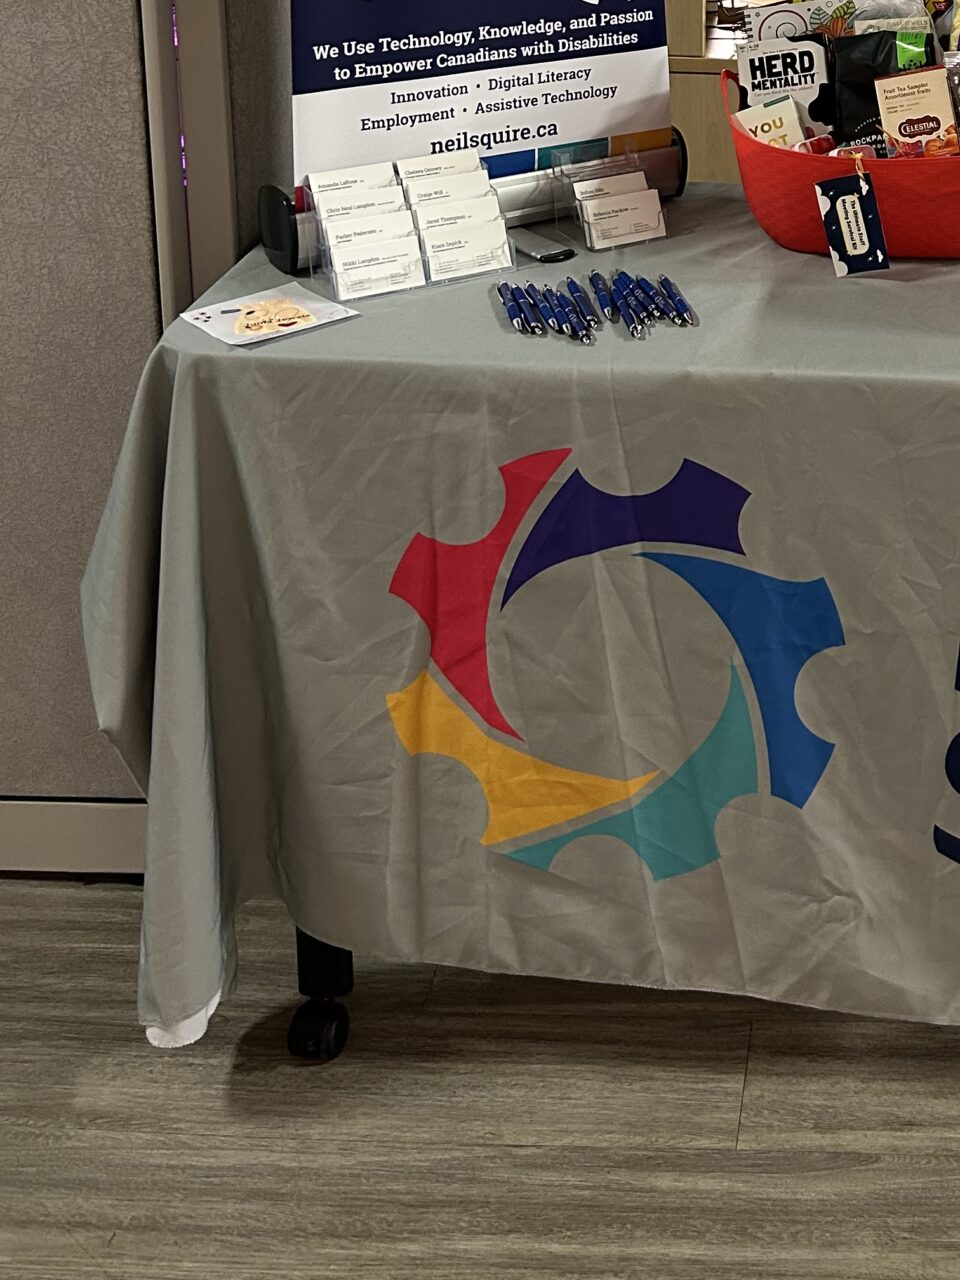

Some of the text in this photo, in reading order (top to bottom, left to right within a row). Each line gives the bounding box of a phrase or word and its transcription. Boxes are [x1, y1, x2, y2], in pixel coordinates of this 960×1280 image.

[313, 8, 654, 60] We Use Technology, Knowledge, and Passion
[334, 32, 639, 81] to Empower Canadians with Disabilities
[748, 50, 815, 80] HERD
[390, 68, 592, 105] Innovation Digital Literacy
[751, 73, 816, 92] MENTALITY
[883, 82, 929, 95] Fruit Tea Sampler
[360, 85, 619, 132] Employment Assistive Technology
[430, 122, 558, 155] neilsquire.ca
[748, 116, 785, 138] YOU
[900, 120, 938, 135] CELESTIAL
